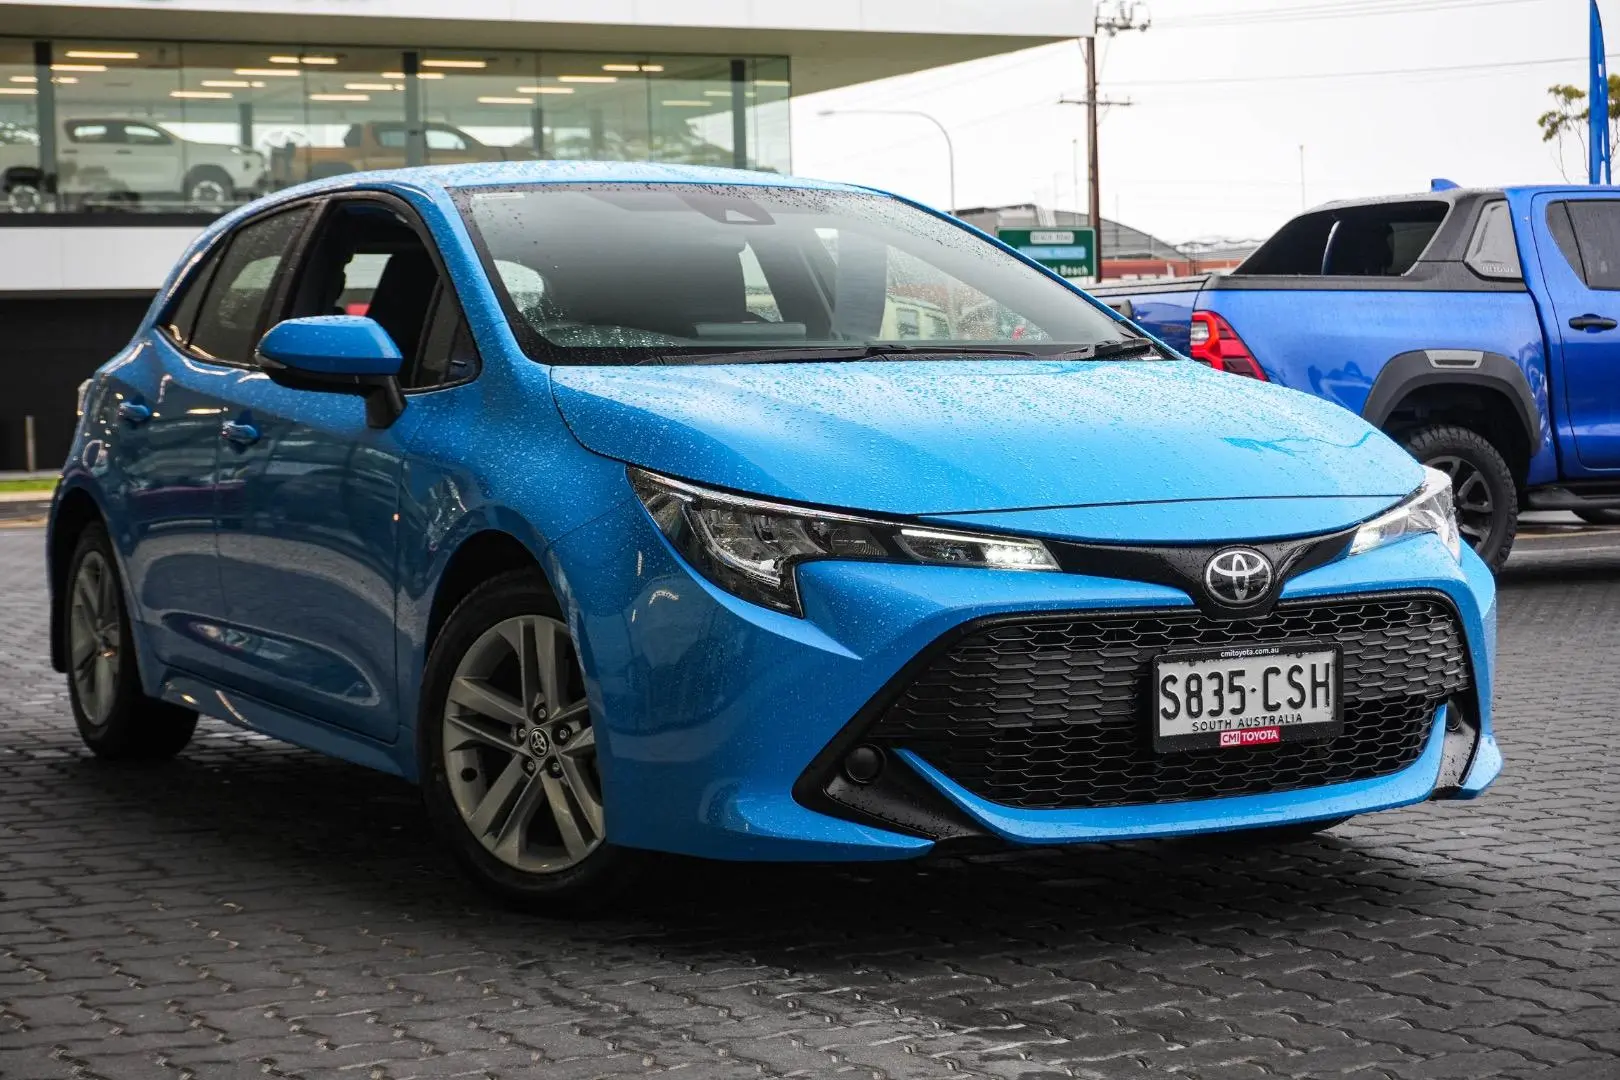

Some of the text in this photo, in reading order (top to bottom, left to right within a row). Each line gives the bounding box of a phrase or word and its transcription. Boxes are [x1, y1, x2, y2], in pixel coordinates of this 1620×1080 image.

[1220, 647, 1280, 658] cmitoyota.com.au
[1192, 713, 1303, 732] SOUTH AUSTRALIA
[1222, 729, 1278, 744] CMI TOYOTA
